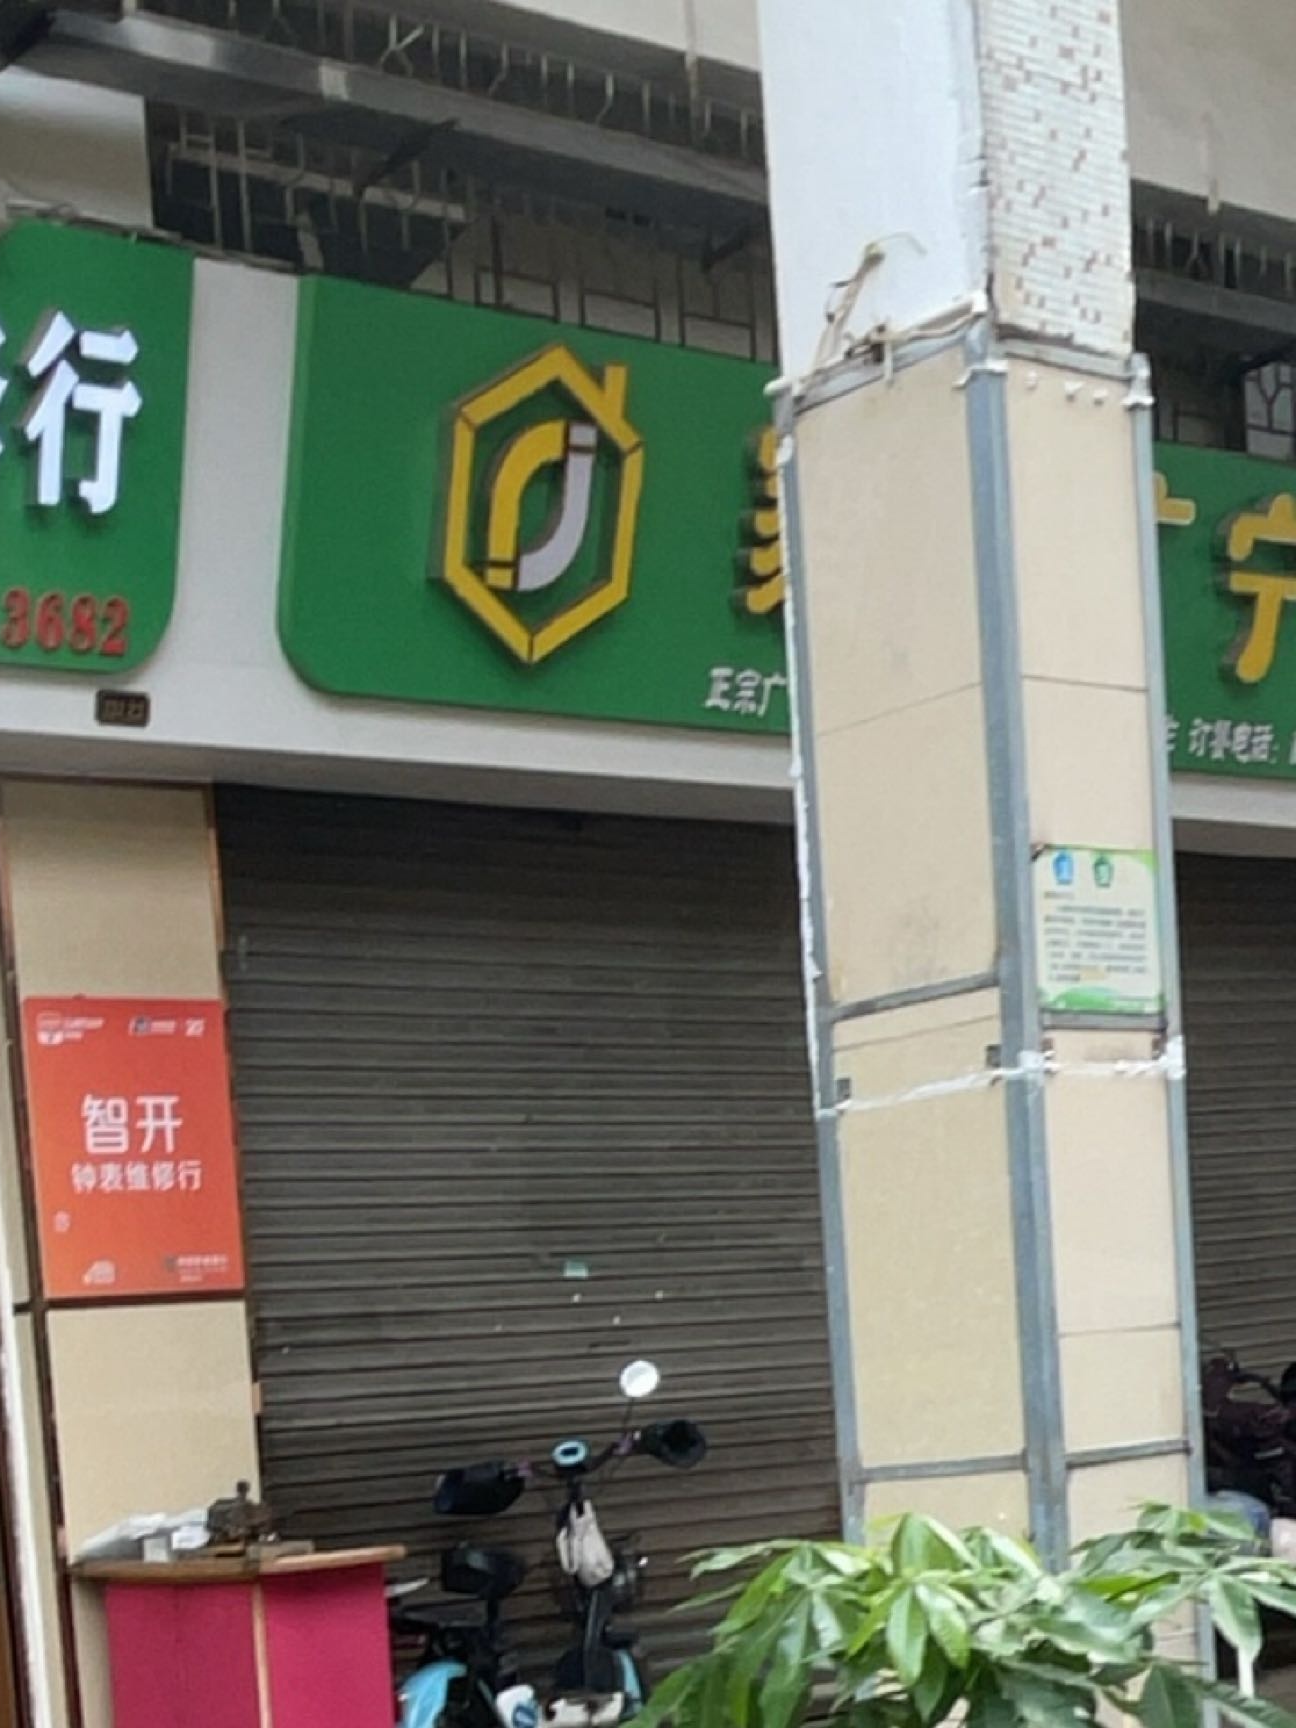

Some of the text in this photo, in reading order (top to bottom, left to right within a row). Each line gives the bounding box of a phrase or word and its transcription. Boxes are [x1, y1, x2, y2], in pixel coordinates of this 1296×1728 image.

[81, 1094, 183, 1154] 智开
[70, 1159, 204, 1193] 钟表维修行
